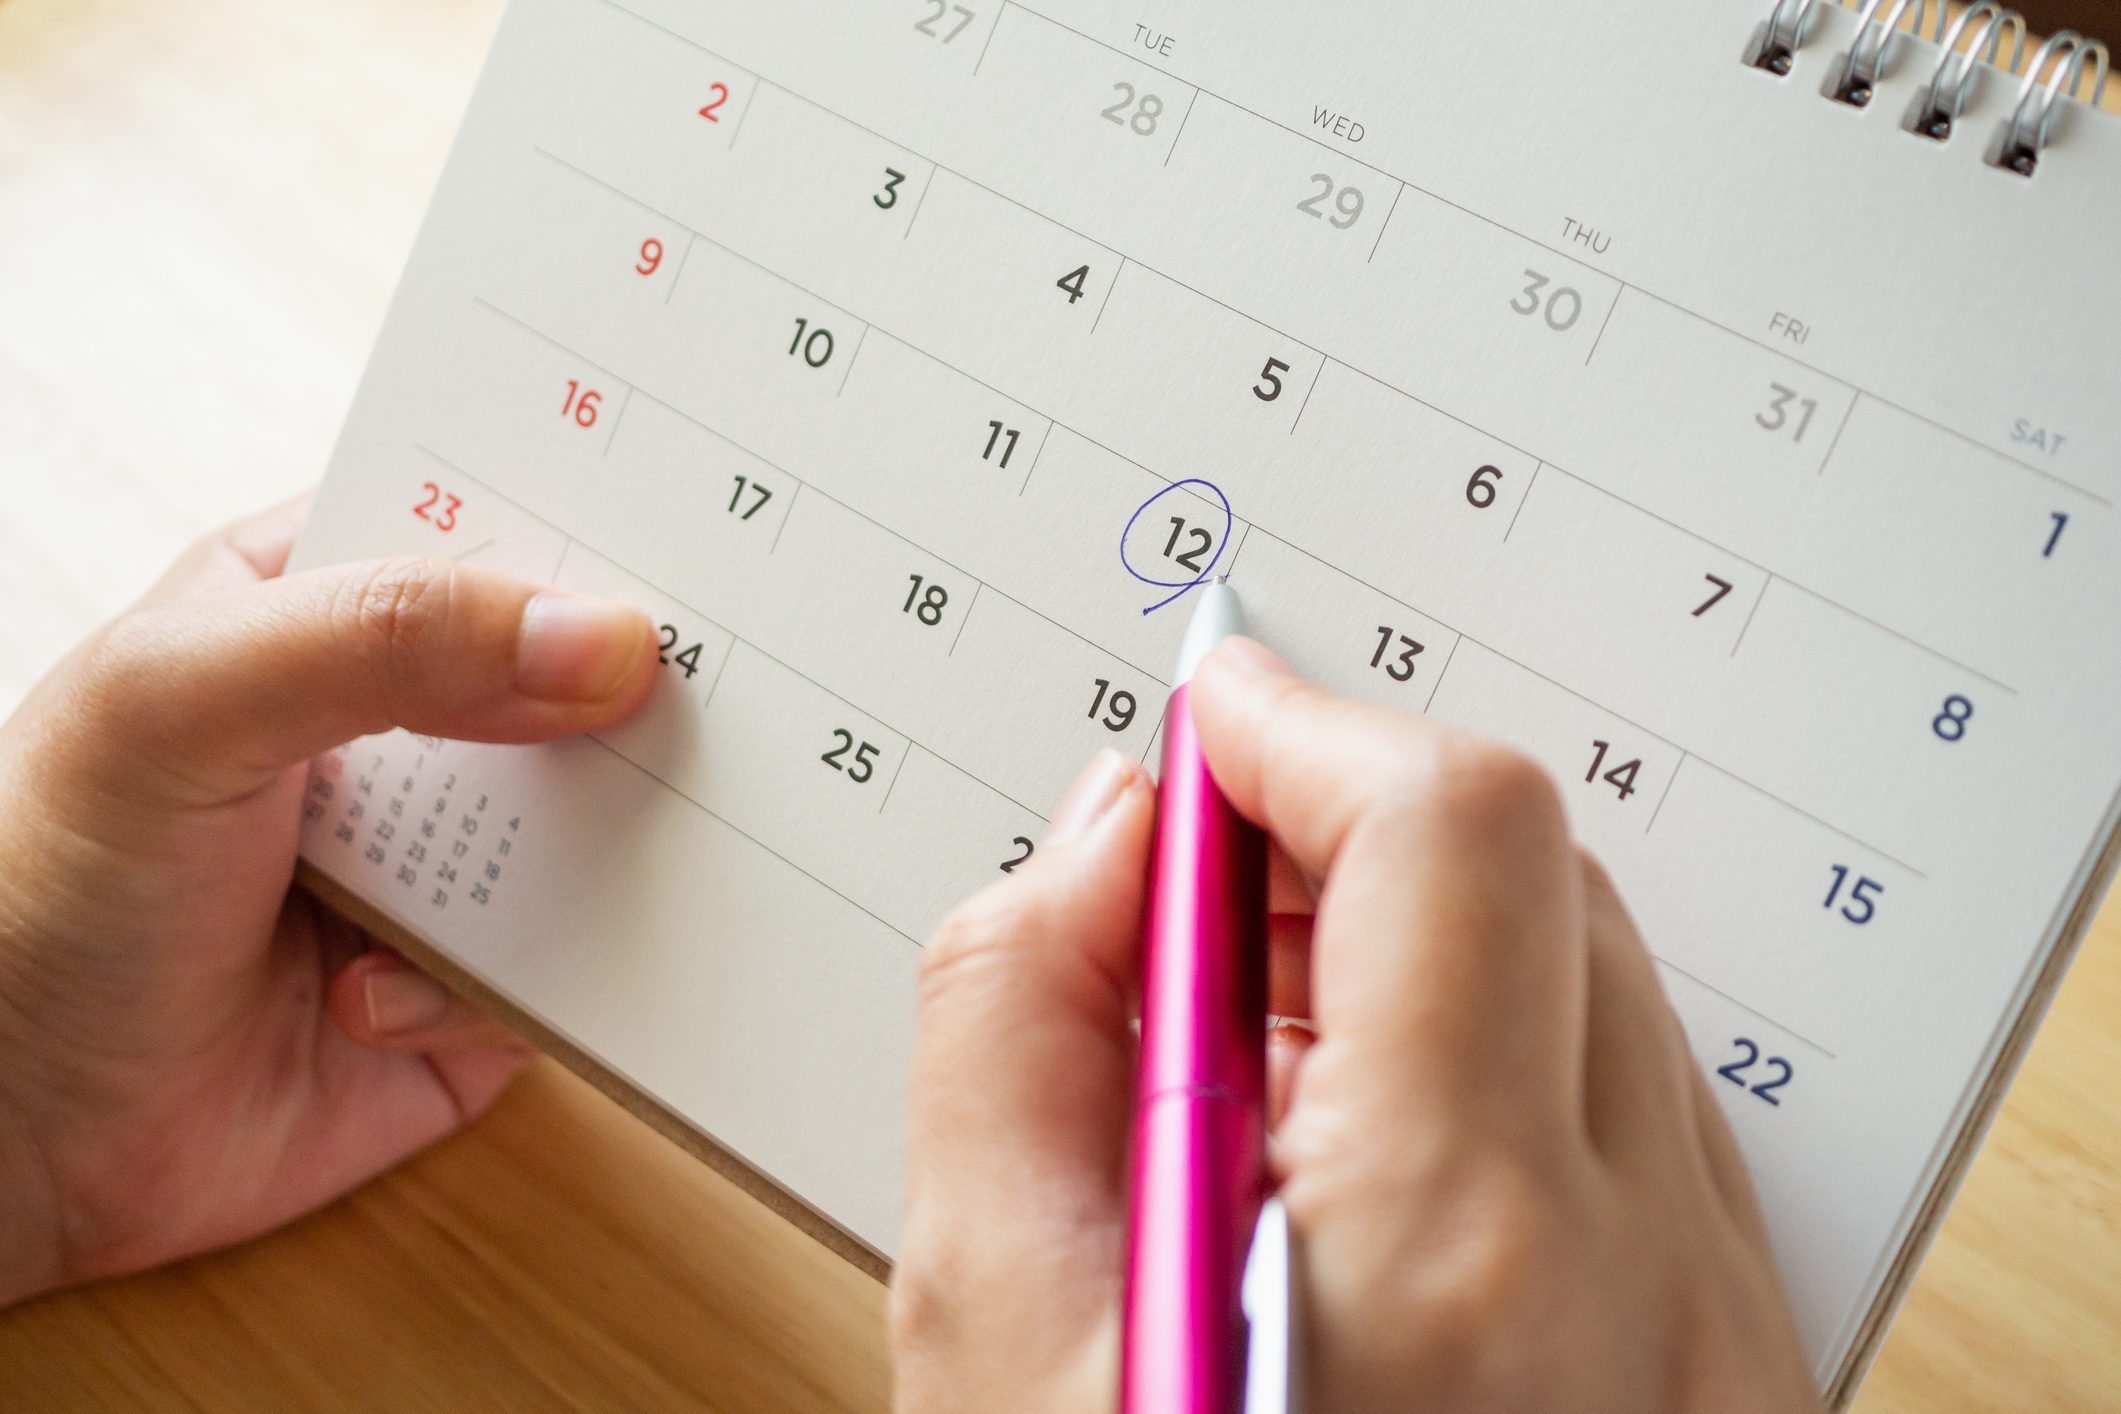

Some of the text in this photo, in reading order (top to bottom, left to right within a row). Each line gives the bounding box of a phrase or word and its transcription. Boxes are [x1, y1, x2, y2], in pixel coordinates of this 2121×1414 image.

[698, 82, 1975, 744] 2 3 4 5 6 7 8
[914, 0, 2070, 559] 27 28 29 30 31 1
[1134, 22, 2067, 456] TUE WED THU FRI SAT
[412, 482, 1036, 875] 23 24 25 2
[561, 379, 1794, 1108] 16 17 18 19 22
[635, 237, 1885, 926] 9 10 11 12 13 14 15
[437, 860, 458, 884] 24
[444, 773, 458, 792] 2
[476, 794, 489, 812] 3
[508, 815, 521, 832] 4
[461, 813, 479, 837] 10
